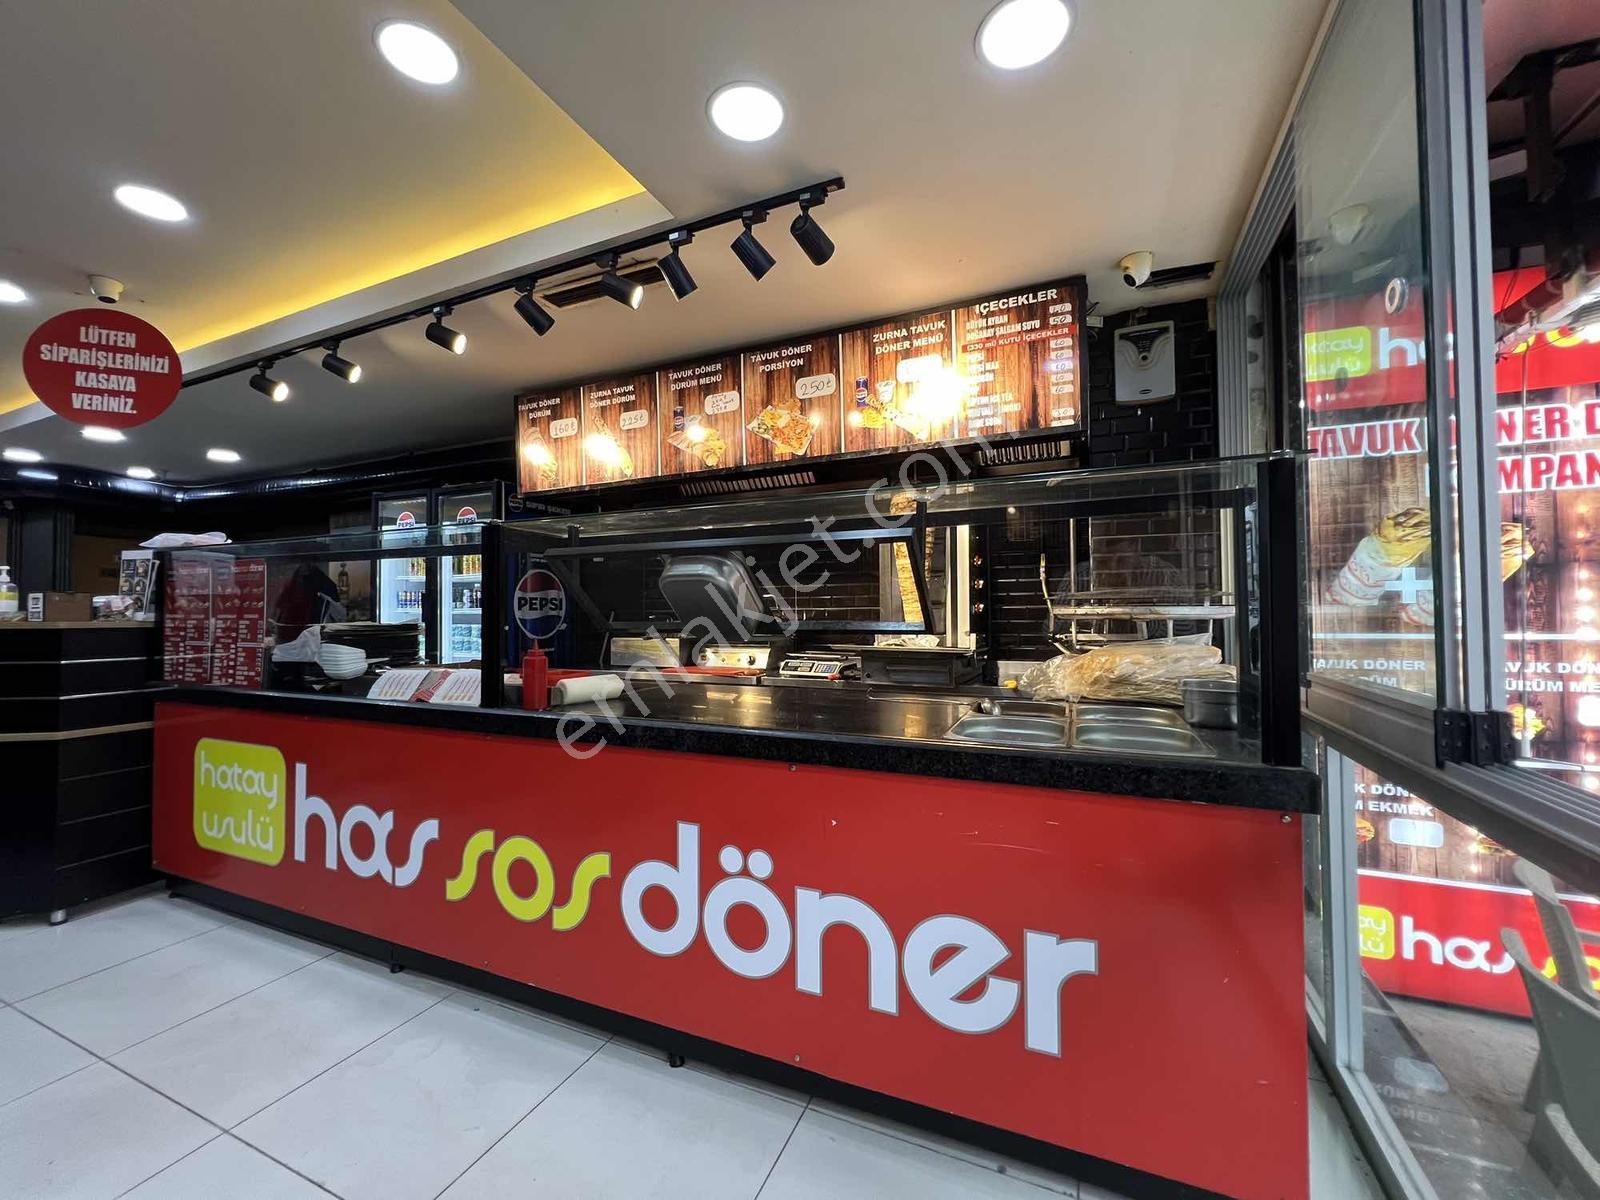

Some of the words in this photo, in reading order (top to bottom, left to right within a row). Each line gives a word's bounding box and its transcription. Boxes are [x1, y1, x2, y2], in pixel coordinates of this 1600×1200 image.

[80, 325, 136, 348] LÜTFEN
[873, 329, 908, 342] ZURNA
[910, 320, 945, 334] TAVUK
[875, 340, 910, 355] DÖNER
[913, 332, 944, 347] MENÜ
[999, 336, 1020, 345] KUTU
[40, 343, 169, 373] SİPARİŞLERİNİZİ
[750, 351, 779, 363] TAVUK
[782, 344, 812, 357] DÖNER
[668, 369, 694, 380] TAVUK
[695, 363, 722, 375] DÖNER
[760, 358, 804, 372] PORSİYON
[75, 371, 136, 392] KASAYA
[671, 380, 698, 391] DÜRÜM
[700, 374, 722, 386] MENÜ
[590, 389, 611, 399] ZURNA
[613, 385, 634, 395] TAVUK
[71, 393, 137, 414] VERİNİZ.
[518, 402, 538, 411] TAVUK
[539, 398, 560, 407] DÖNER
[590, 399, 611, 408] DÖNER
[612, 394, 636, 404] DÜRÜM
[529, 409, 551, 419] DÜRÜM
[518, 596, 563, 612] PEPSI
[1364, 657, 1426, 671] DÖNER
[200, 750, 278, 810] hatay
[1368, 800, 1434, 817] EKMEK
[202, 808, 273, 852] usulü
[294, 763, 439, 888] has
[446, 829, 611, 931] sos
[620, 819, 1099, 1058] döner
